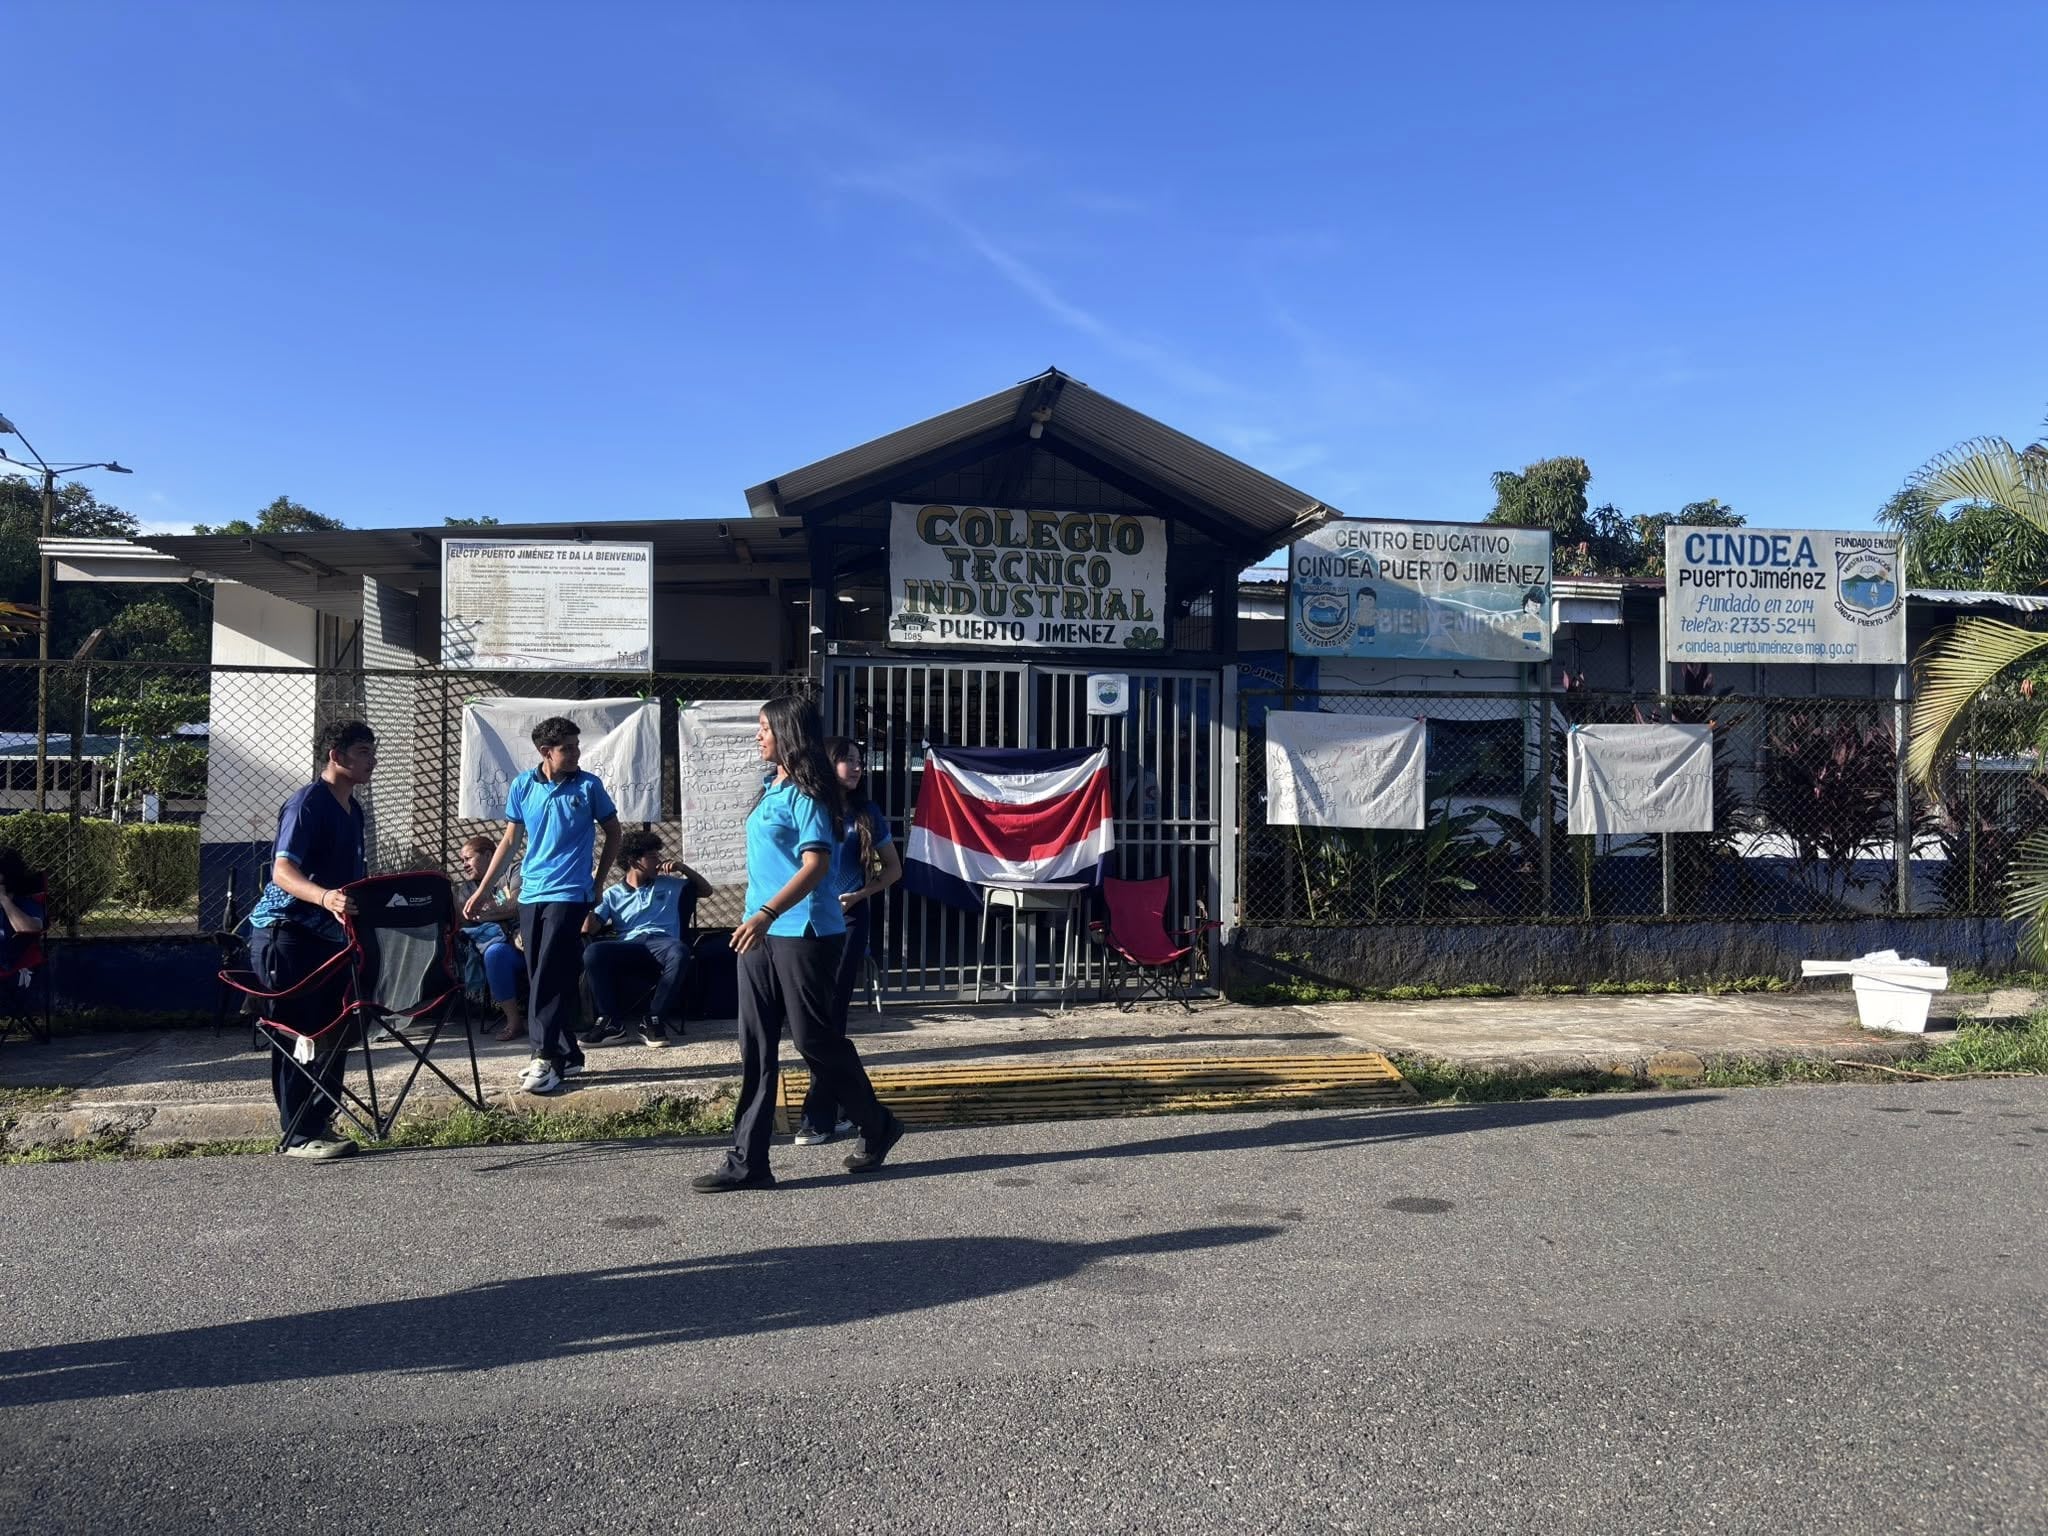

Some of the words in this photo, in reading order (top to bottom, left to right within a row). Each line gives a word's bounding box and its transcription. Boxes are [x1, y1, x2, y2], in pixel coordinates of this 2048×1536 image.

[916, 505, 1145, 555] COLEGIO
[1335, 529, 1407, 550] CENTRO
[1412, 533, 1510, 554] EDUCATIVO
[1835, 537, 1873, 548] FUNDADO
[1874, 539, 1884, 548] EN
[450, 549, 460, 558] EL
[463, 549, 480, 558] CTP
[481, 549, 516, 559] PUERTO
[517, 548, 555, 560] JIMÉNEZ
[557, 551, 567, 559] TE
[569, 551, 581, 560] DA
[582, 552, 593, 560] LA
[596, 552, 647, 562] BIENVENIDA
[1685, 533, 1818, 568] CINDEA
[942, 548, 1111, 588] TECNICO
[1297, 556, 1373, 578] CINDEA
[1379, 559, 1458, 582] PUERTO
[1463, 560, 1546, 586] JIMÉNEZ
[1749, 567, 1826, 590] Jiménez
[903, 579, 1154, 622] INDUSTRIAL
[1764, 599, 1782, 614] en
[1785, 599, 1815, 614] 2014
[1834, 601, 1856, 623] CINDEA
[940, 618, 1025, 642] PUERTO
[1036, 623, 1117, 644] JIMENEZ
